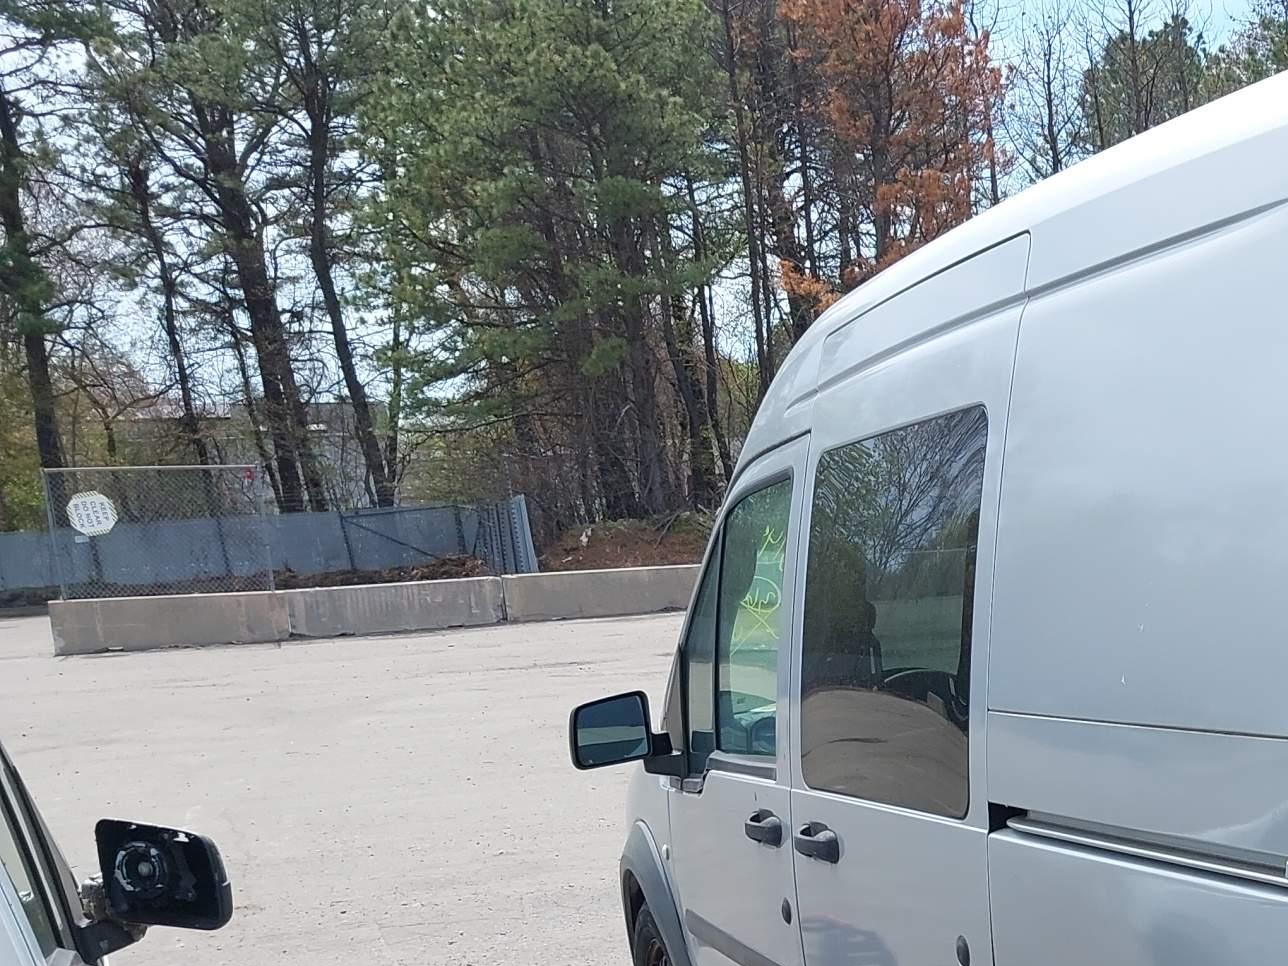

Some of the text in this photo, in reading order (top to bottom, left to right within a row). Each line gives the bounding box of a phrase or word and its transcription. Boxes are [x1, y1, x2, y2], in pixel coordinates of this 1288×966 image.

[73, 503, 87, 529] BLOCK
[80, 500, 95, 528] DO NOT
[90, 500, 102, 525] CLEAR
[98, 501, 109, 521] KEEP
